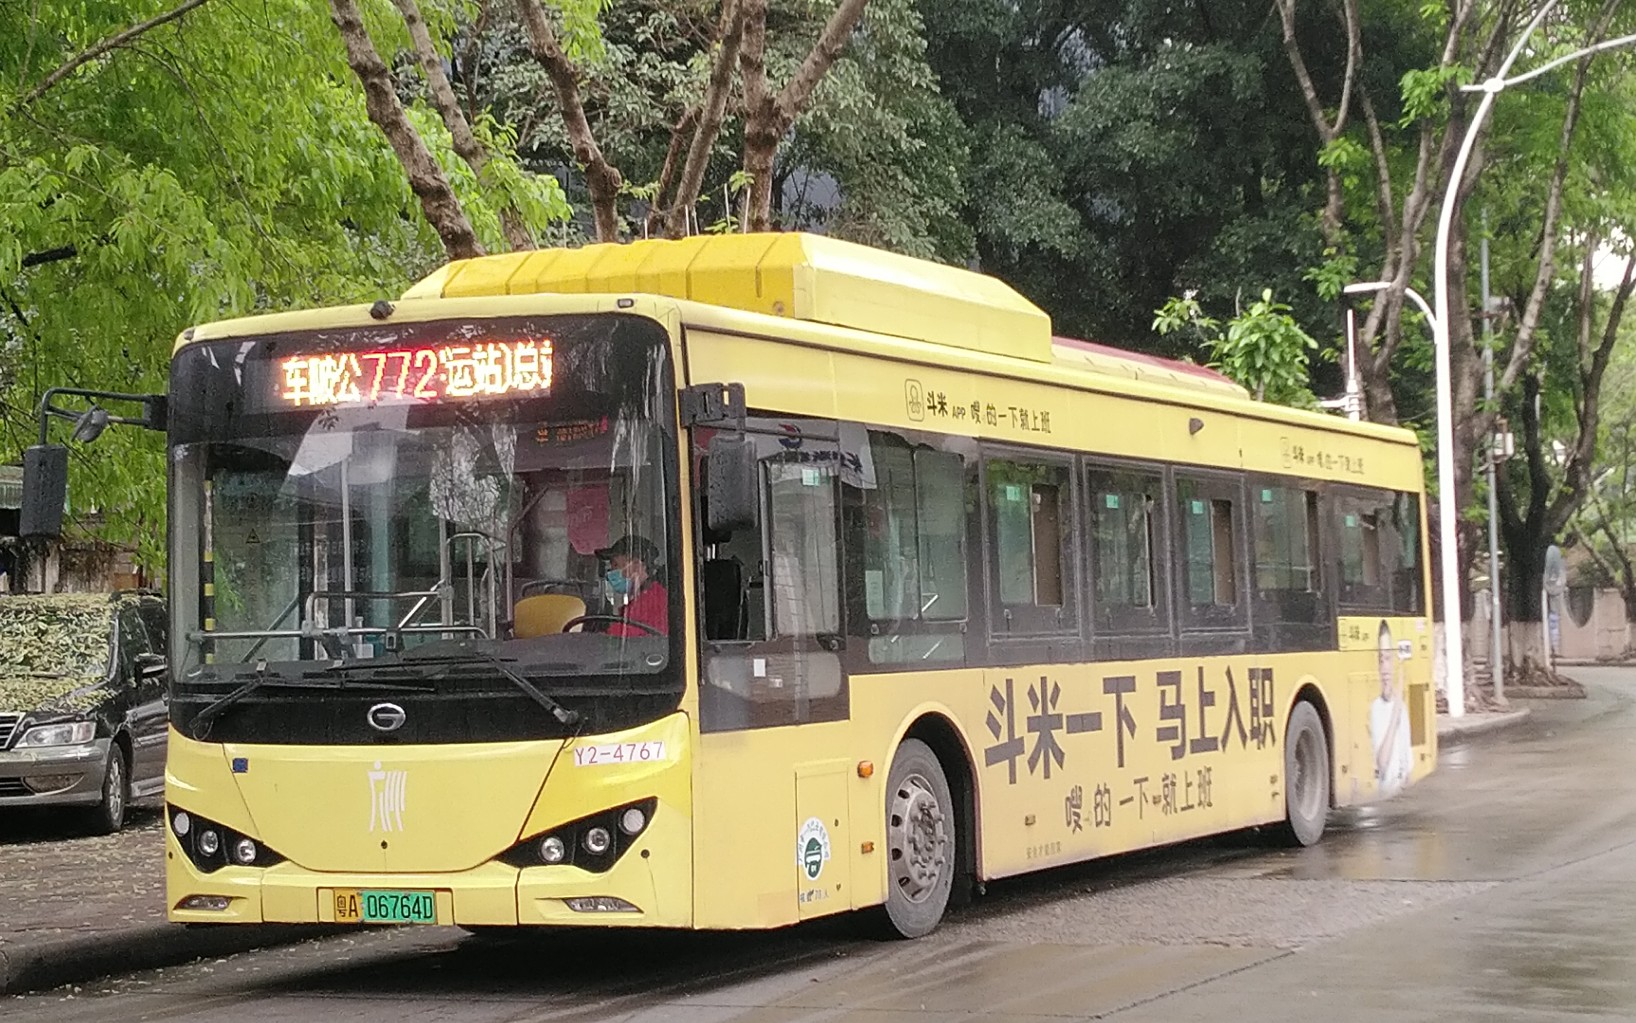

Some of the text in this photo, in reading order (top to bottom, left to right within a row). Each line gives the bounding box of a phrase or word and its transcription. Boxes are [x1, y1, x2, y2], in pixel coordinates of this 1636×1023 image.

[362, 350, 438, 400] 772
[439, 339, 553, 396] 运站)总
[926, 390, 949, 417] 斗米
[952, 405, 967, 420] APP
[984, 665, 1276, 785] 斗米一下 马上入职
[575, 741, 663, 766] Y2-4767
[367, 894, 434, 919] 06764D
